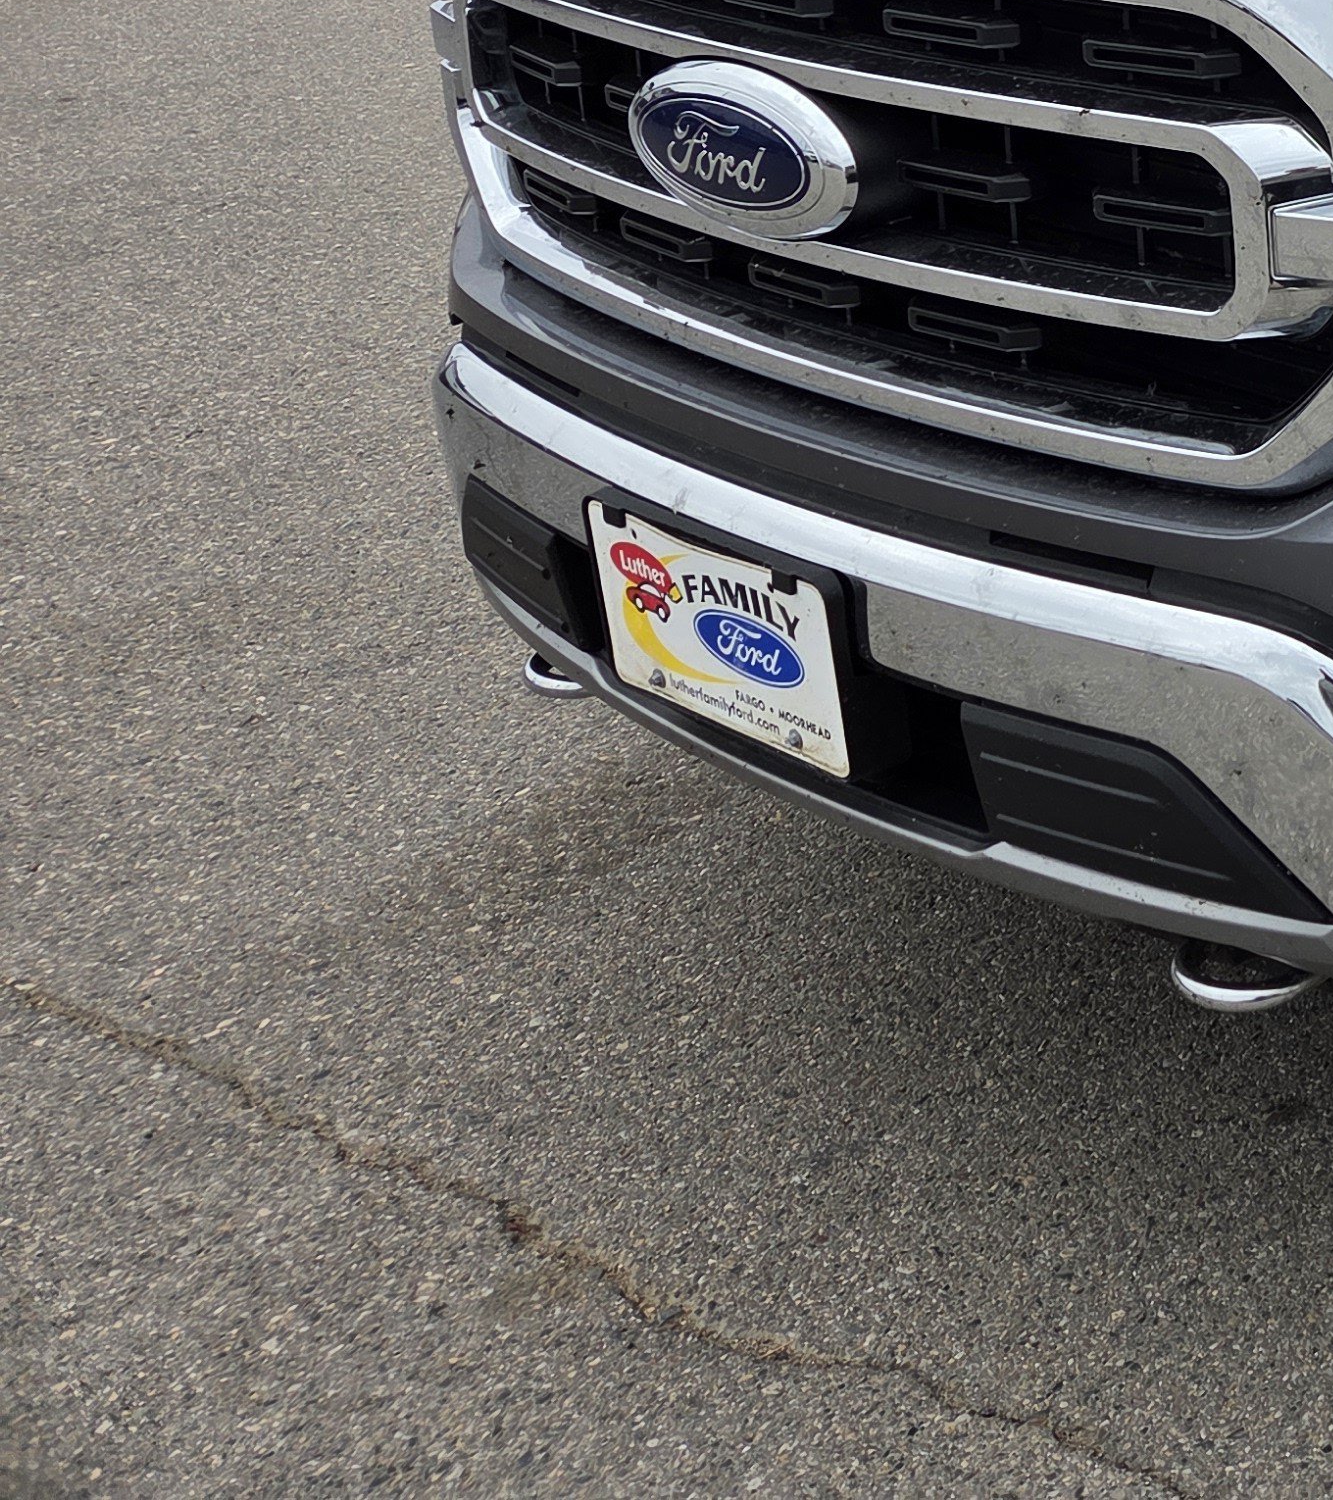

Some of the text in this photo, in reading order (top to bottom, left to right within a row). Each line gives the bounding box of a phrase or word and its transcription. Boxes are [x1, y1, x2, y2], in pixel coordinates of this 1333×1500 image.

[666, 110, 767, 194] Ford
[619, 549, 667, 588] Luther
[682, 574, 800, 642] FAMILY
[717, 619, 782, 676] Ford
[670, 673, 780, 736] lutherfamilyford.com
[734, 689, 832, 740] FARGO MOORHEAD
